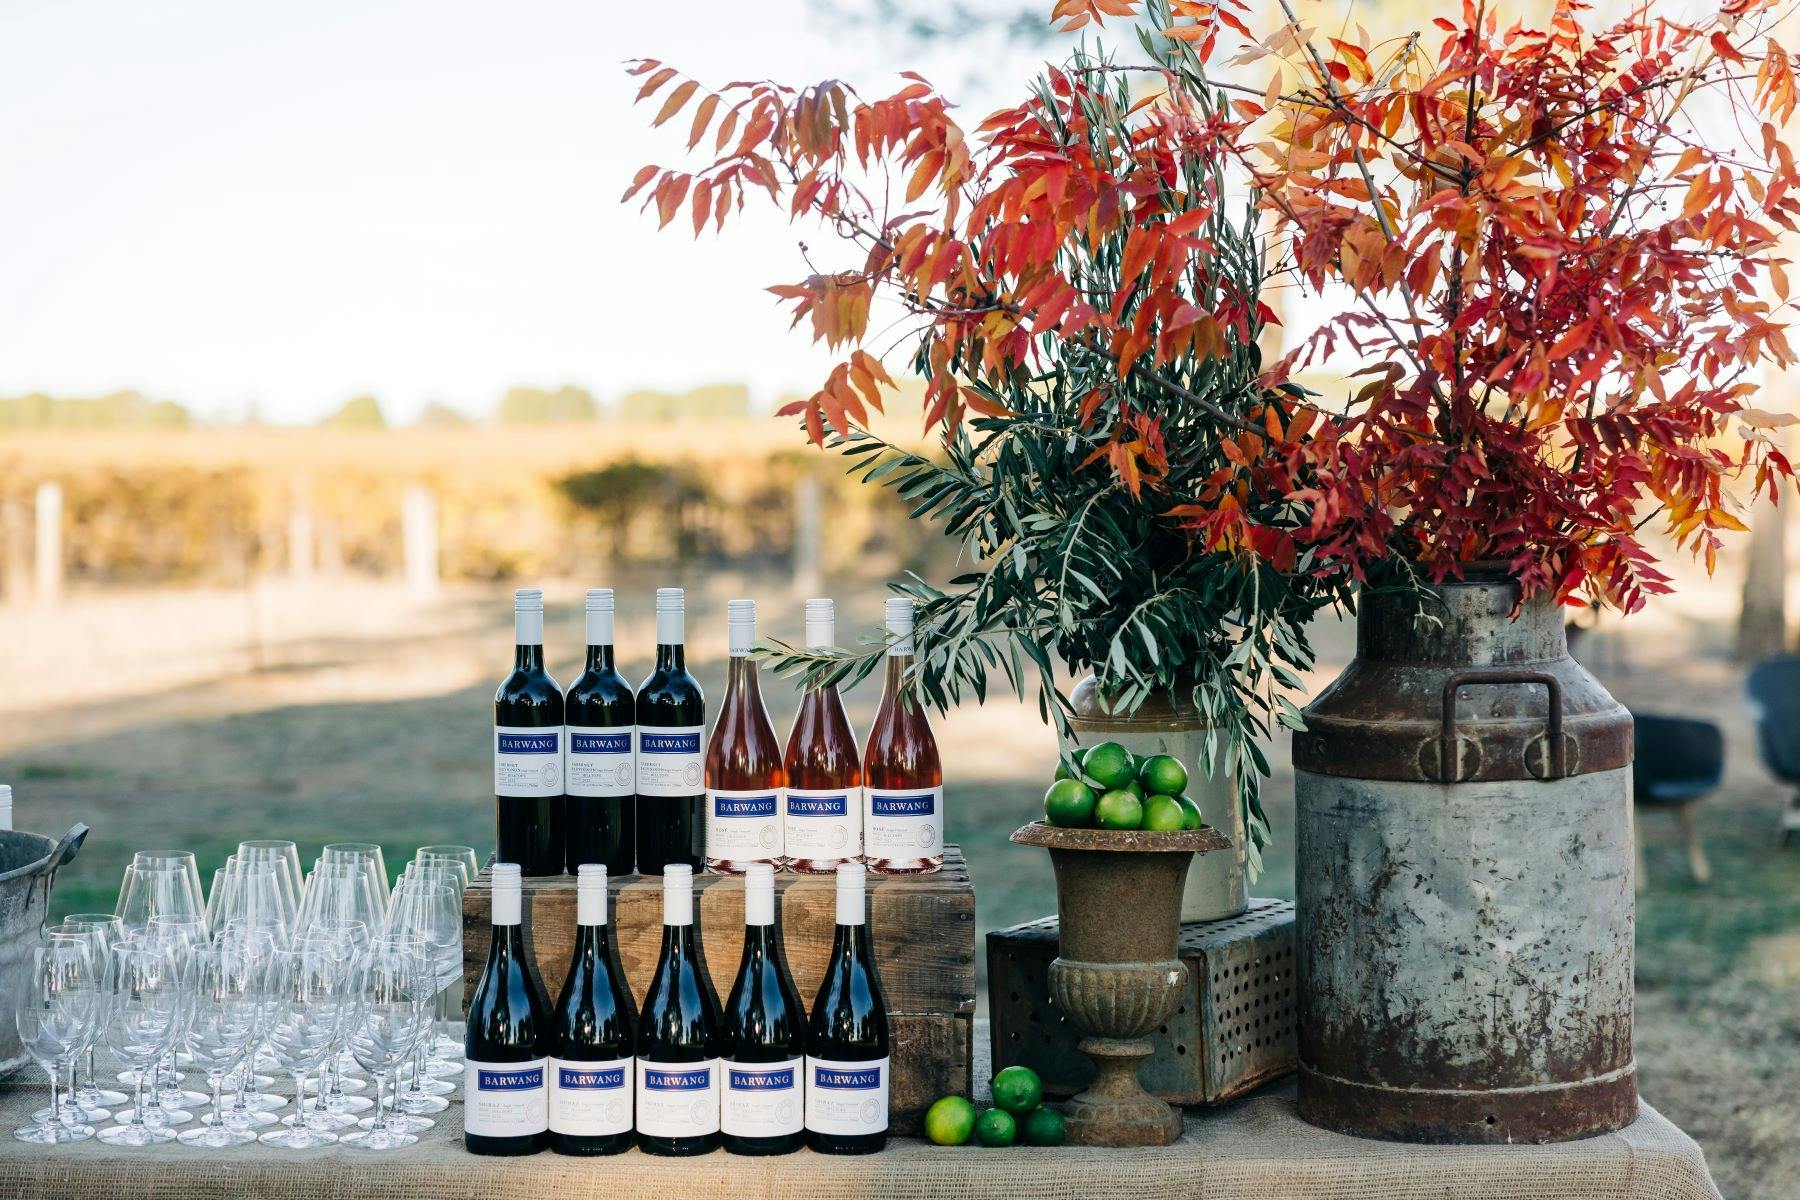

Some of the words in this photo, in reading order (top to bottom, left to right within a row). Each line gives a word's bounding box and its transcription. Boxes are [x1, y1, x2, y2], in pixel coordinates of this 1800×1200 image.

[502, 740, 553, 749] BARWANG
[576, 740, 628, 749] BARWANG
[645, 740, 696, 749] BARWANG
[720, 803, 772, 812] BARWANG
[790, 802, 841, 811] BARWANG
[877, 802, 929, 811] BARWANG
[485, 1076, 539, 1086] BARWANG
[565, 1075, 620, 1085] BARWANG
[650, 1076, 705, 1087] BARWANG
[734, 1076, 790, 1087] BARWANG
[820, 1075, 875, 1085] BARWANG
